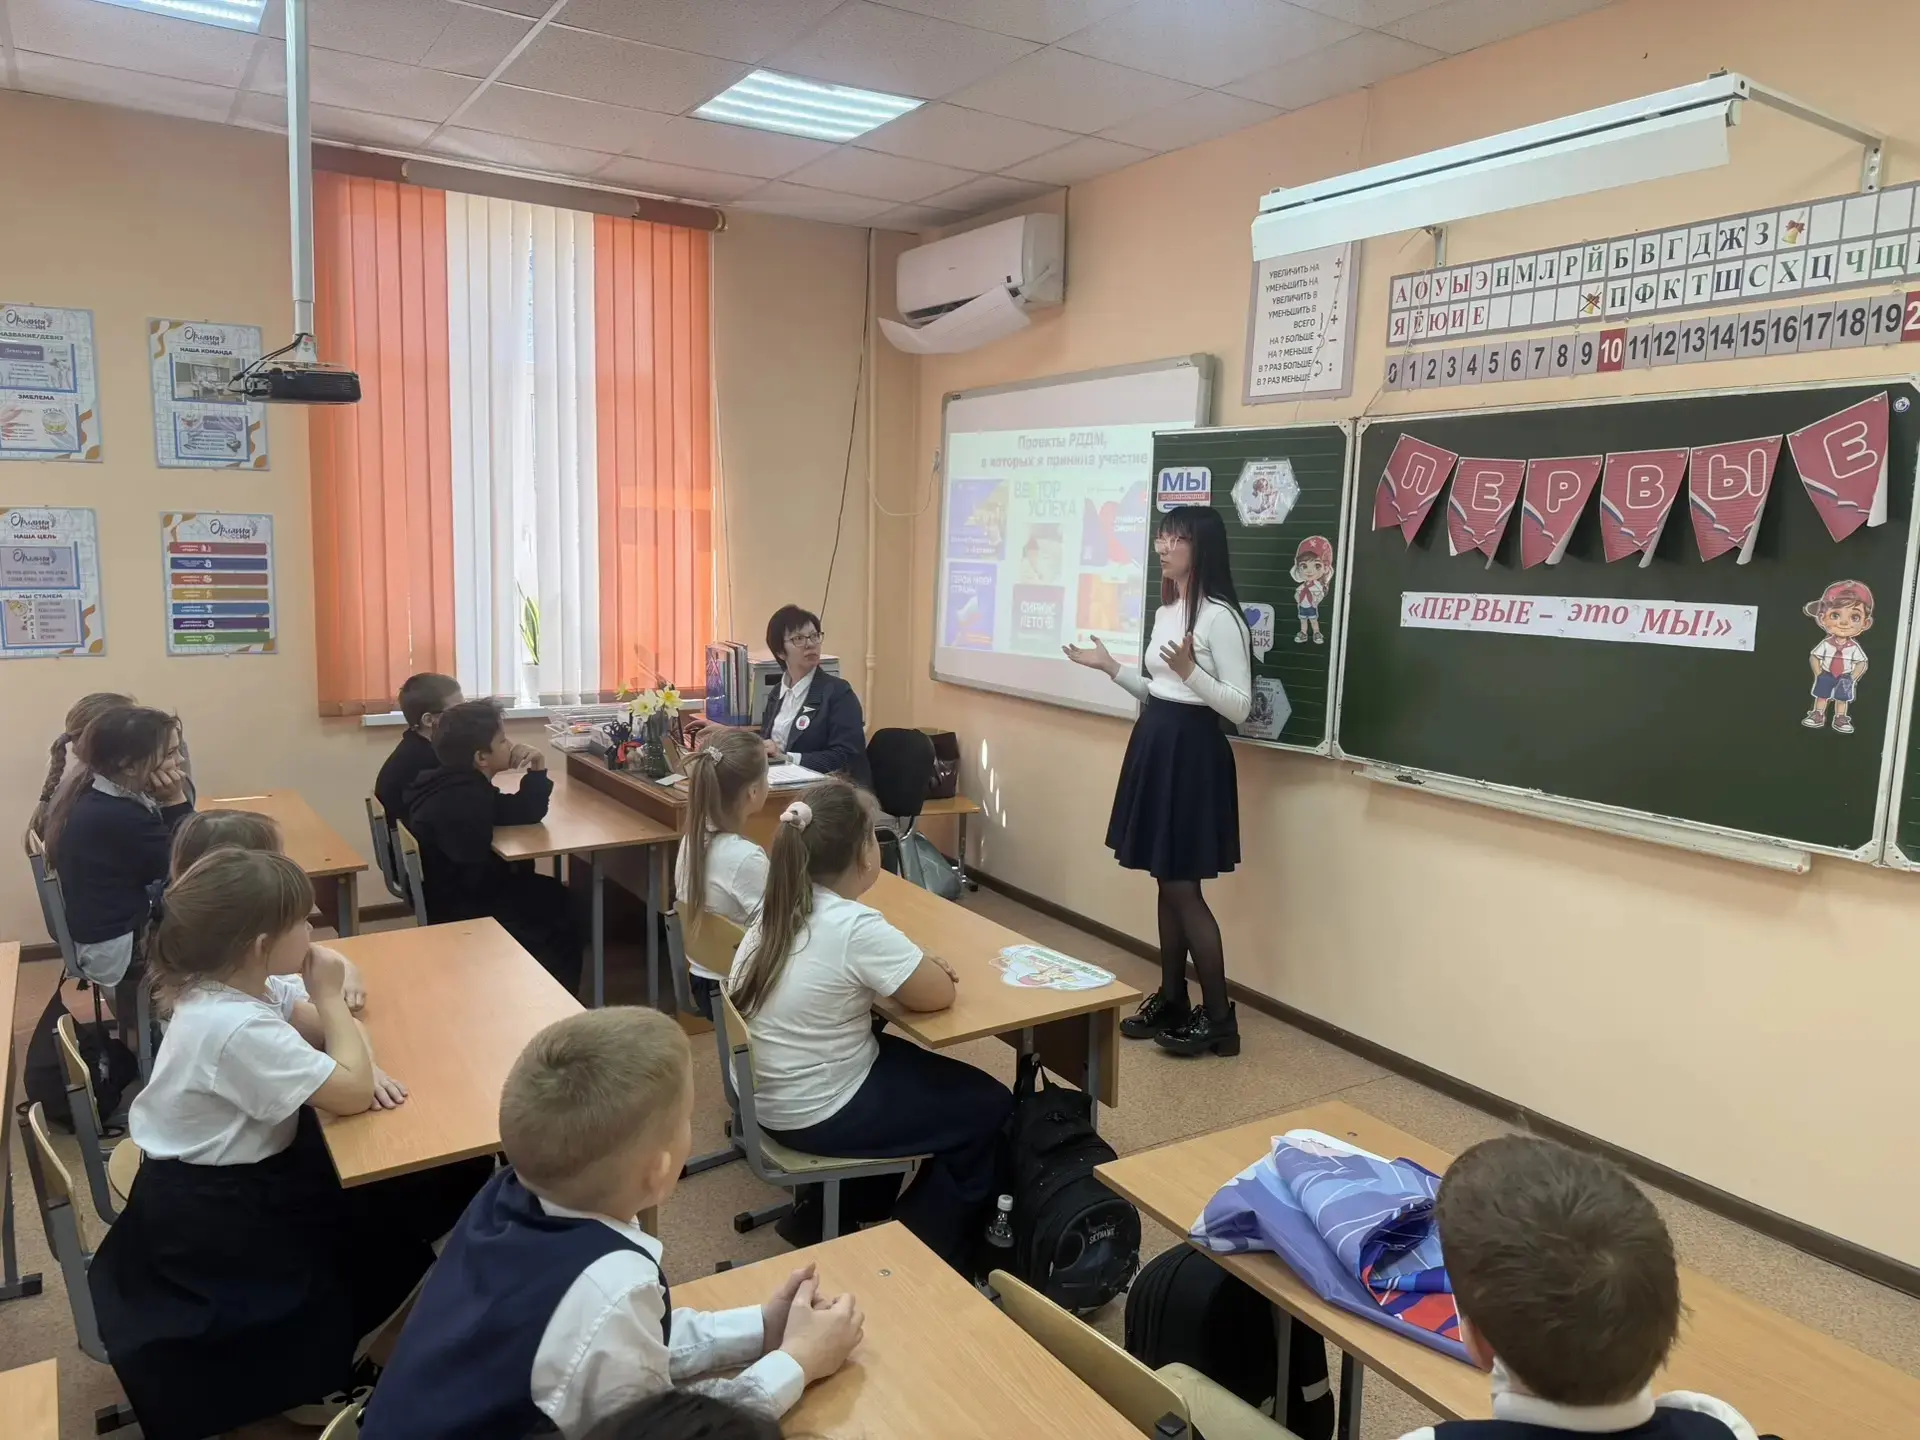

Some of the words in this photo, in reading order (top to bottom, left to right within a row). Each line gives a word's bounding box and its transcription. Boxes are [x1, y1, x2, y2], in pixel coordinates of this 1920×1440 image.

[1269, 265, 1308, 279] УВЕЛИЧИТЬ
[1310, 263, 1319, 271] НА
[1395, 286, 1408, 304] А
[1415, 281, 1428, 300] О
[1435, 277, 1449, 297] У
[1452, 273, 1470, 294] Ы
[1475, 270, 1488, 290] Э
[1495, 266, 1510, 287] Н
[1516, 262, 1534, 284] М
[1539, 259, 1555, 280] Л
[1564, 255, 1578, 276] Р
[1587, 245, 1603, 272] Й
[1613, 247, 1629, 269] Б
[1640, 242, 1655, 265] В
[1666, 238, 1683, 260] Г
[1692, 232, 1712, 260] Д
[1719, 226, 1746, 251] Ж
[1755, 222, 1769, 246] З
[1265, 279, 1307, 293] УМЕНЬШИТЬ
[1309, 277, 1318, 286] НА
[1393, 317, 1406, 336] Я
[1414, 307, 1424, 334] Ё
[1428, 310, 1448, 331] Ю
[1450, 308, 1465, 328] И
[1473, 306, 1485, 325] Е
[1609, 286, 1627, 308] П
[1635, 279, 1655, 303] Ф
[1662, 277, 1681, 300] К
[1692, 273, 1708, 296] Т
[1715, 268, 1742, 293] Ш
[1749, 264, 1768, 288] С
[1778, 259, 1799, 284] Х
[1810, 253, 1833, 282] Ц
[1846, 249, 1866, 273] Ч
[1873, 243, 1907, 274] Щ
[1272, 292, 1311, 304] УВЕЛИЧИТЬ
[1268, 305, 1310, 319] УМЕНЬШИТЬ
[1293, 319, 1315, 328] ВСЕГО
[1269, 337, 1279, 345] НА
[1285, 332, 1314, 343] БОЛЬШЕ
[1388, 362, 1397, 384] 0
[1410, 361, 1416, 381] 1
[1427, 358, 1436, 380] 2
[1447, 356, 1457, 378] 3
[1467, 354, 1478, 375] 4
[1488, 351, 1499, 374] 5
[1511, 349, 1522, 372] 6
[1534, 347, 1545, 370] 7
[1557, 344, 1568, 368] 8
[1581, 341, 1593, 365] 9
[1601, 337, 1622, 364] 10
[1629, 333, 1650, 360] 11
[1653, 330, 1677, 356] 12
[1681, 326, 1706, 353] 13
[1710, 322, 1735, 350] 14
[1740, 319, 1766, 347] 15
[1771, 315, 1798, 344] 16
[1803, 311, 1833, 340] 17
[1836, 307, 1865, 337] 18
[1871, 303, 1902, 333] 19
[1267, 350, 1277, 358] НА
[1283, 346, 1313, 356] МЕНЬШЕ
[1269, 363, 1282, 371] РАЗ
[1283, 360, 1312, 370] БОЛЬШЕ
[1256, 378, 1261, 386] В
[1267, 376, 1280, 385] РАЗ
[1281, 374, 1311, 384] МЕНЬШЕ
[1018, 435, 1065, 450] Проекты
[990, 456, 1033, 469] которых
[1098, 453, 1148, 469] участие
[1014, 480, 1061, 499] ВЕТОР
[1162, 472, 1206, 491] МЫ
[1408, 597, 1534, 624] «ПЕРВЫЕ
[1567, 602, 1629, 625] это
[1639, 608, 1733, 636] МЫ!»
